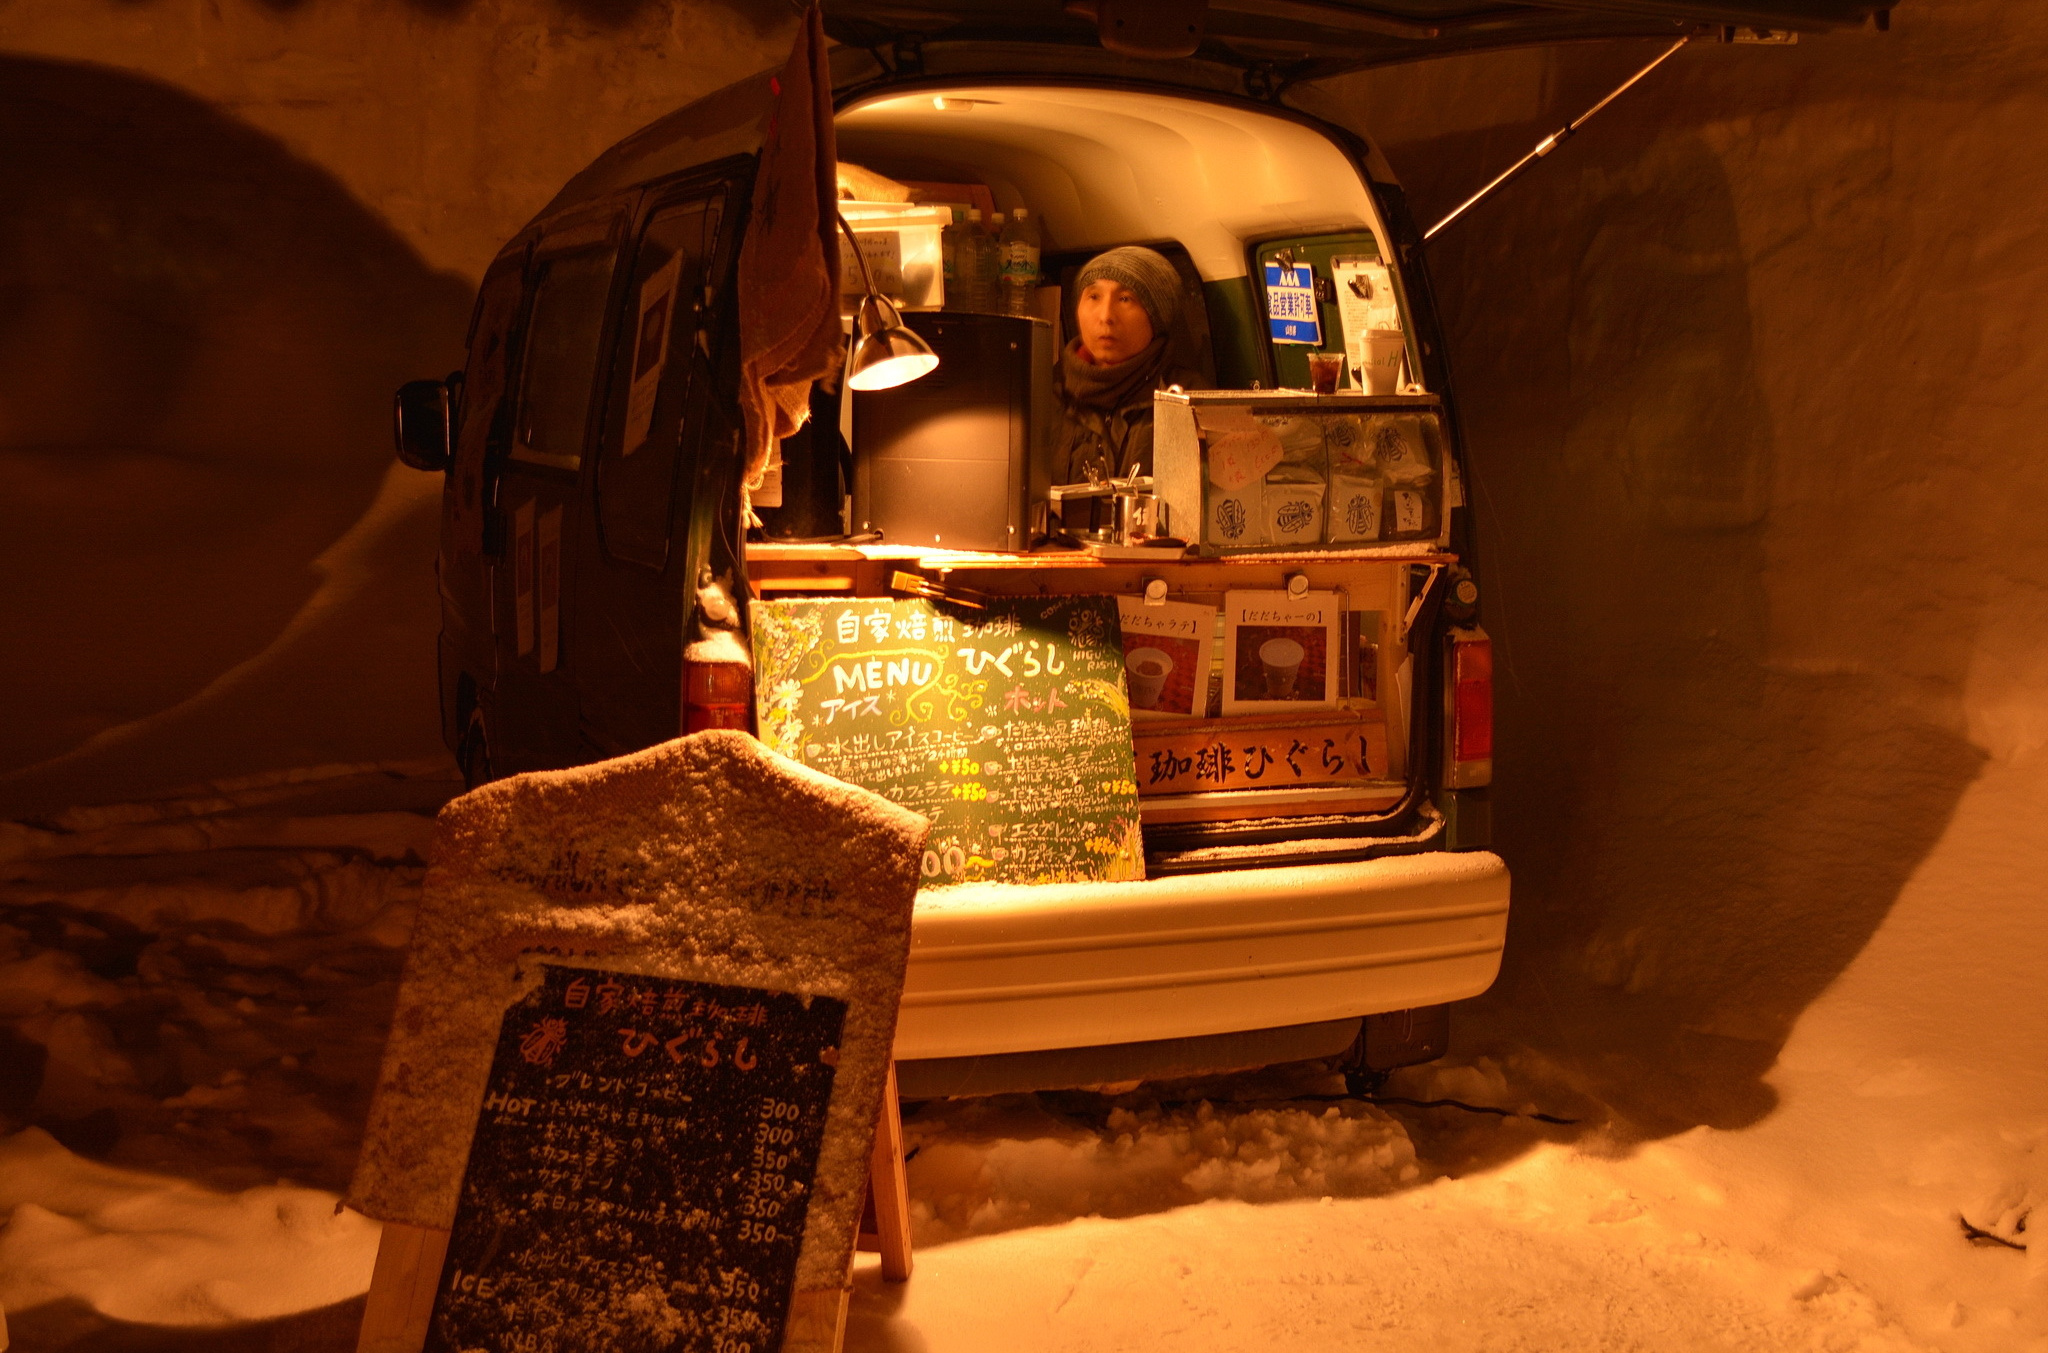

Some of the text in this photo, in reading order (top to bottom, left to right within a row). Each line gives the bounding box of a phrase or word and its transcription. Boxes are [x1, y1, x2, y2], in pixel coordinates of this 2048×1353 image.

[956, 640, 1065, 678] ひぐらし
[832, 657, 934, 694] MENU
[820, 694, 883, 725] アイス
[1004, 685, 1068, 716] ホット
[1134, 735, 1372, 785] 珈琲ひぐらし
[617, 1027, 758, 1072] ひぐらし
[485, 1091, 538, 1117] HOT
[759, 1097, 800, 1121] 300
[755, 1122, 794, 1146] 300
[749, 1169, 786, 1192] 350
[743, 1194, 781, 1218] 350
[452, 1269, 496, 1299] ICE
